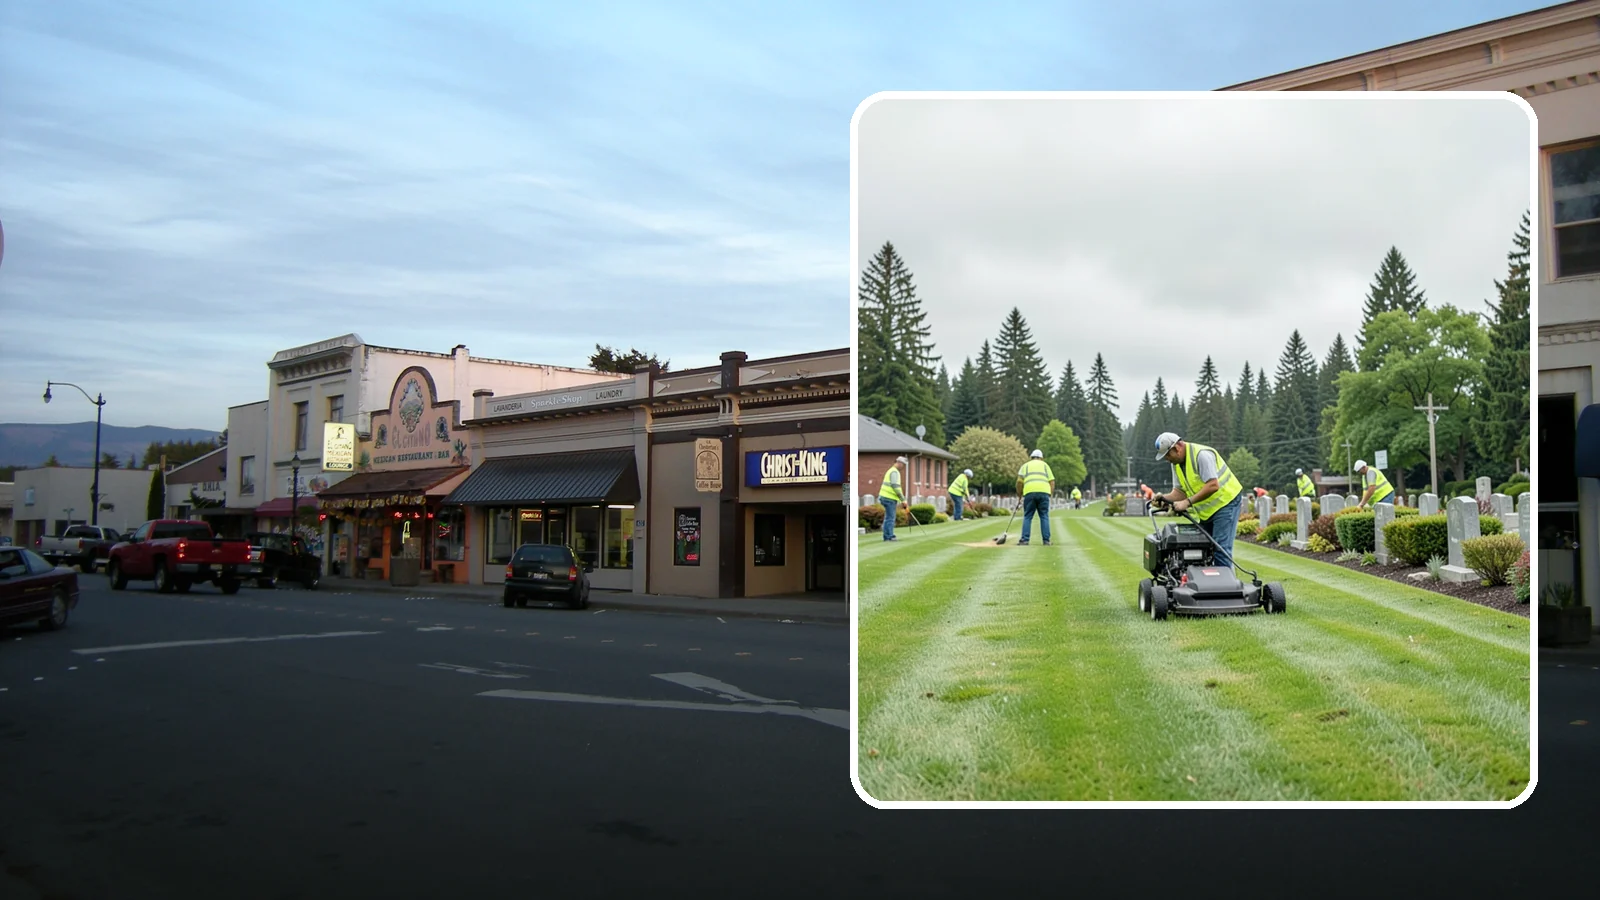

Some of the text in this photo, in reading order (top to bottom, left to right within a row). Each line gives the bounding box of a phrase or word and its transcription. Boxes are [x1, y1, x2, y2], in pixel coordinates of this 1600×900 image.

[595, 389, 623, 400] LAUNDRY
[493, 402, 523, 413] LAVANDERIA
[398, 451, 434, 461] RESTAURANT
[438, 450, 450, 459] BAR
